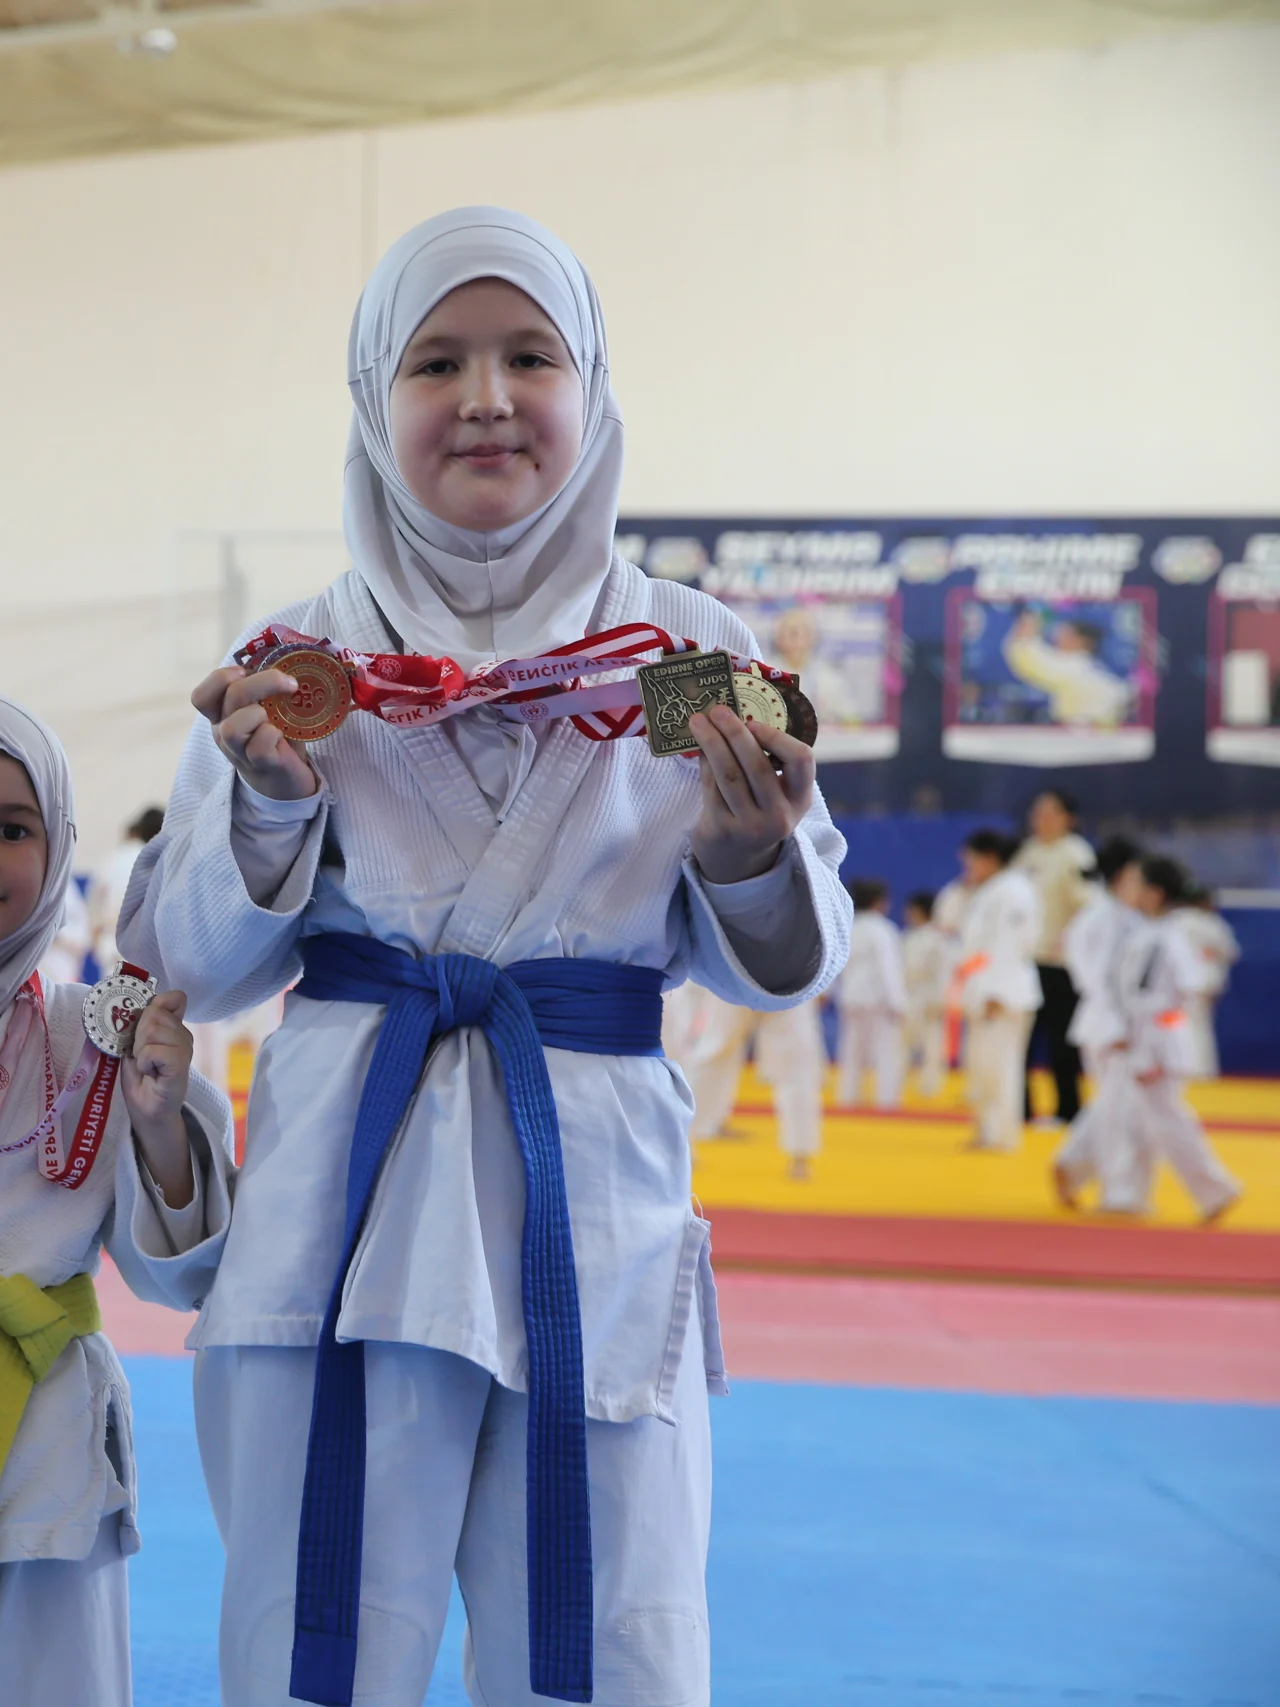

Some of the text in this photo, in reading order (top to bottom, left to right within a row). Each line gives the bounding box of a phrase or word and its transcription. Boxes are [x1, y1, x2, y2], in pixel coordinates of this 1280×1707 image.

[695, 655, 726, 669] OPEN
[698, 673, 728, 687] JUDO
[78, 1056, 117, 1154] UMHURİYETİ
